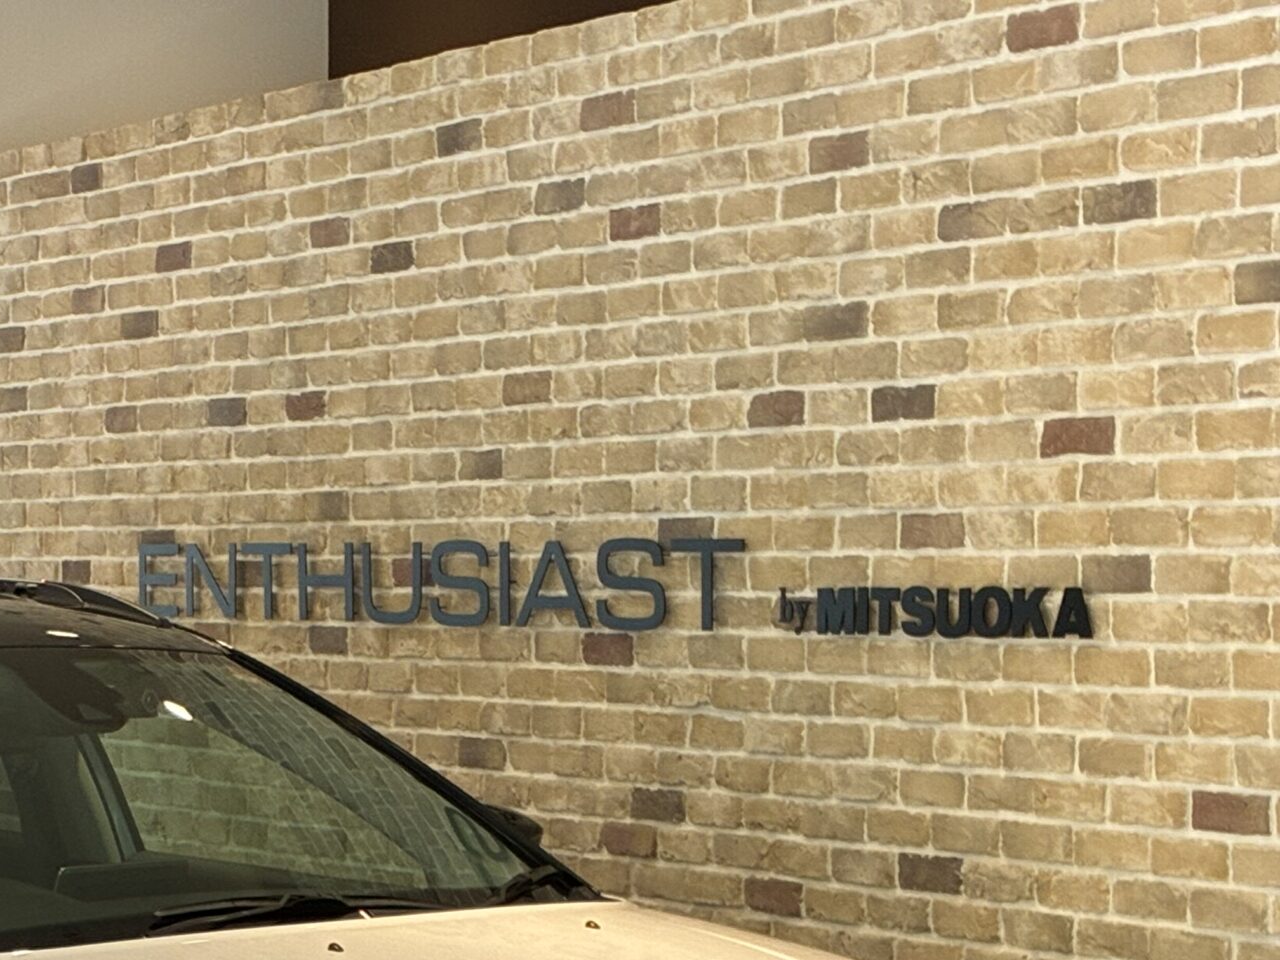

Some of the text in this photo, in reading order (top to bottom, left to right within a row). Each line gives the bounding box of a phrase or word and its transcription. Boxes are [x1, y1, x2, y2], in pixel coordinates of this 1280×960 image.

[138, 537, 746, 632] ENTHUSIAST
[778, 586, 1093, 639] by MITSUOKA
